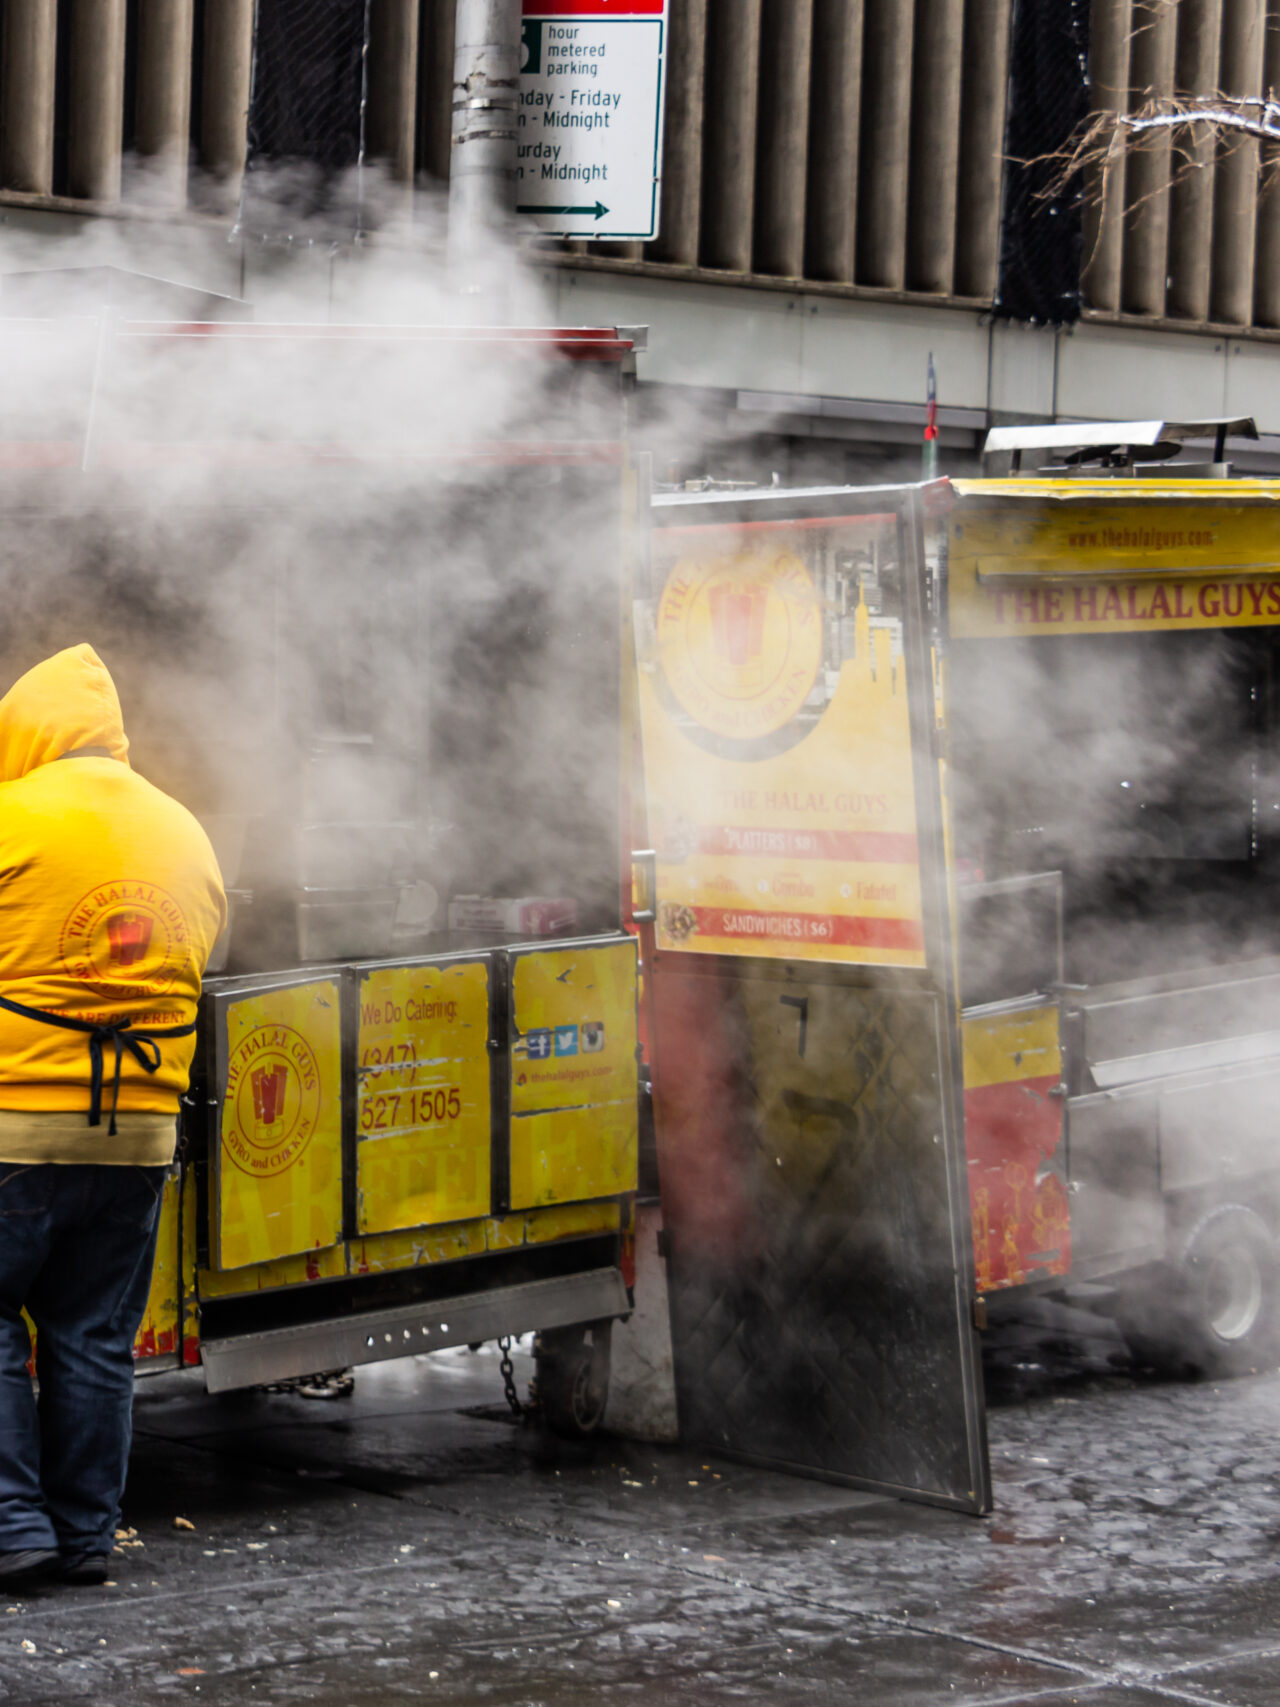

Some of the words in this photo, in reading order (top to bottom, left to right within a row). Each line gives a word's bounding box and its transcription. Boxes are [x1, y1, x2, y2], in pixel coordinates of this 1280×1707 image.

[549, 26, 579, 40] hour
[548, 43, 606, 58] metered
[547, 61, 598, 78] parking
[519, 89, 554, 110] nday
[570, 90, 621, 110] Friday
[543, 111, 610, 131] Midnight
[517, 142, 561, 161] urday
[541, 163, 608, 183] Midnight
[1068, 525, 1214, 550] www.thehalalguys.com
[987, 586, 1065, 625] THE
[1072, 582, 1193, 621] HALAL
[1198, 581, 1280, 618] GUYS
[764, 792, 829, 813] HALAL
[834, 793, 887, 815] GUYS
[69, 904, 95, 939] THE
[94, 885, 157, 907] HALAL
[160, 900, 186, 943] GUYS
[722, 914, 801, 937] SANDWICHES
[361, 1004, 381, 1026] We
[384, 1001, 401, 1024] Do
[405, 998, 458, 1024] Catering:
[225, 1061, 243, 1101] THE
[240, 1030, 288, 1062] HALAL
[291, 1042, 317, 1091] GUYS
[363, 1043, 417, 1088] (347)
[361, 1095, 401, 1130] 527
[411, 1088, 461, 1124] 1505
[228, 1130, 250, 1163] GYRO
[251, 1156, 269, 1169] and
[270, 1118, 312, 1168] CHICKEN
